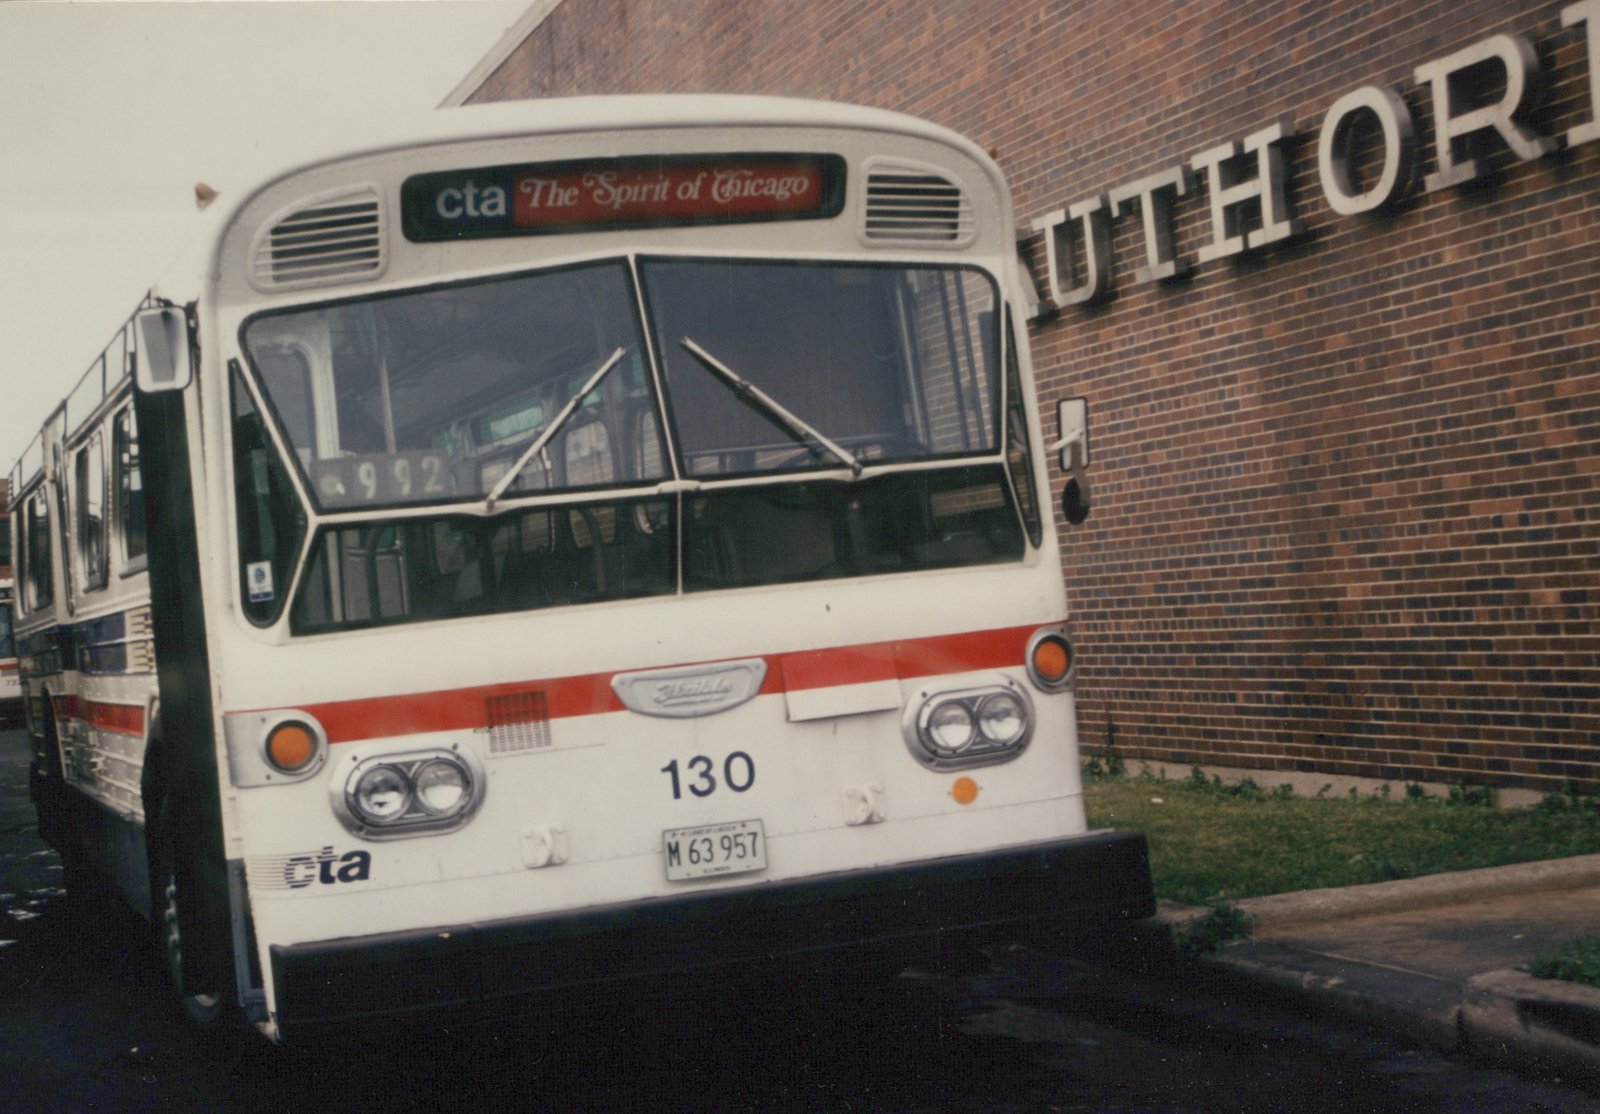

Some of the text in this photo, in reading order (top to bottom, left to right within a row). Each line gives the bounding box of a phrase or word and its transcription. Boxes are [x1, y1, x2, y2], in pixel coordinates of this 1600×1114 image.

[436, 170, 809, 219] cta The Spirit of Chicago
[661, 751, 756, 800] 130
[284, 845, 372, 888] cta
[667, 832, 758, 867] M 63 957
